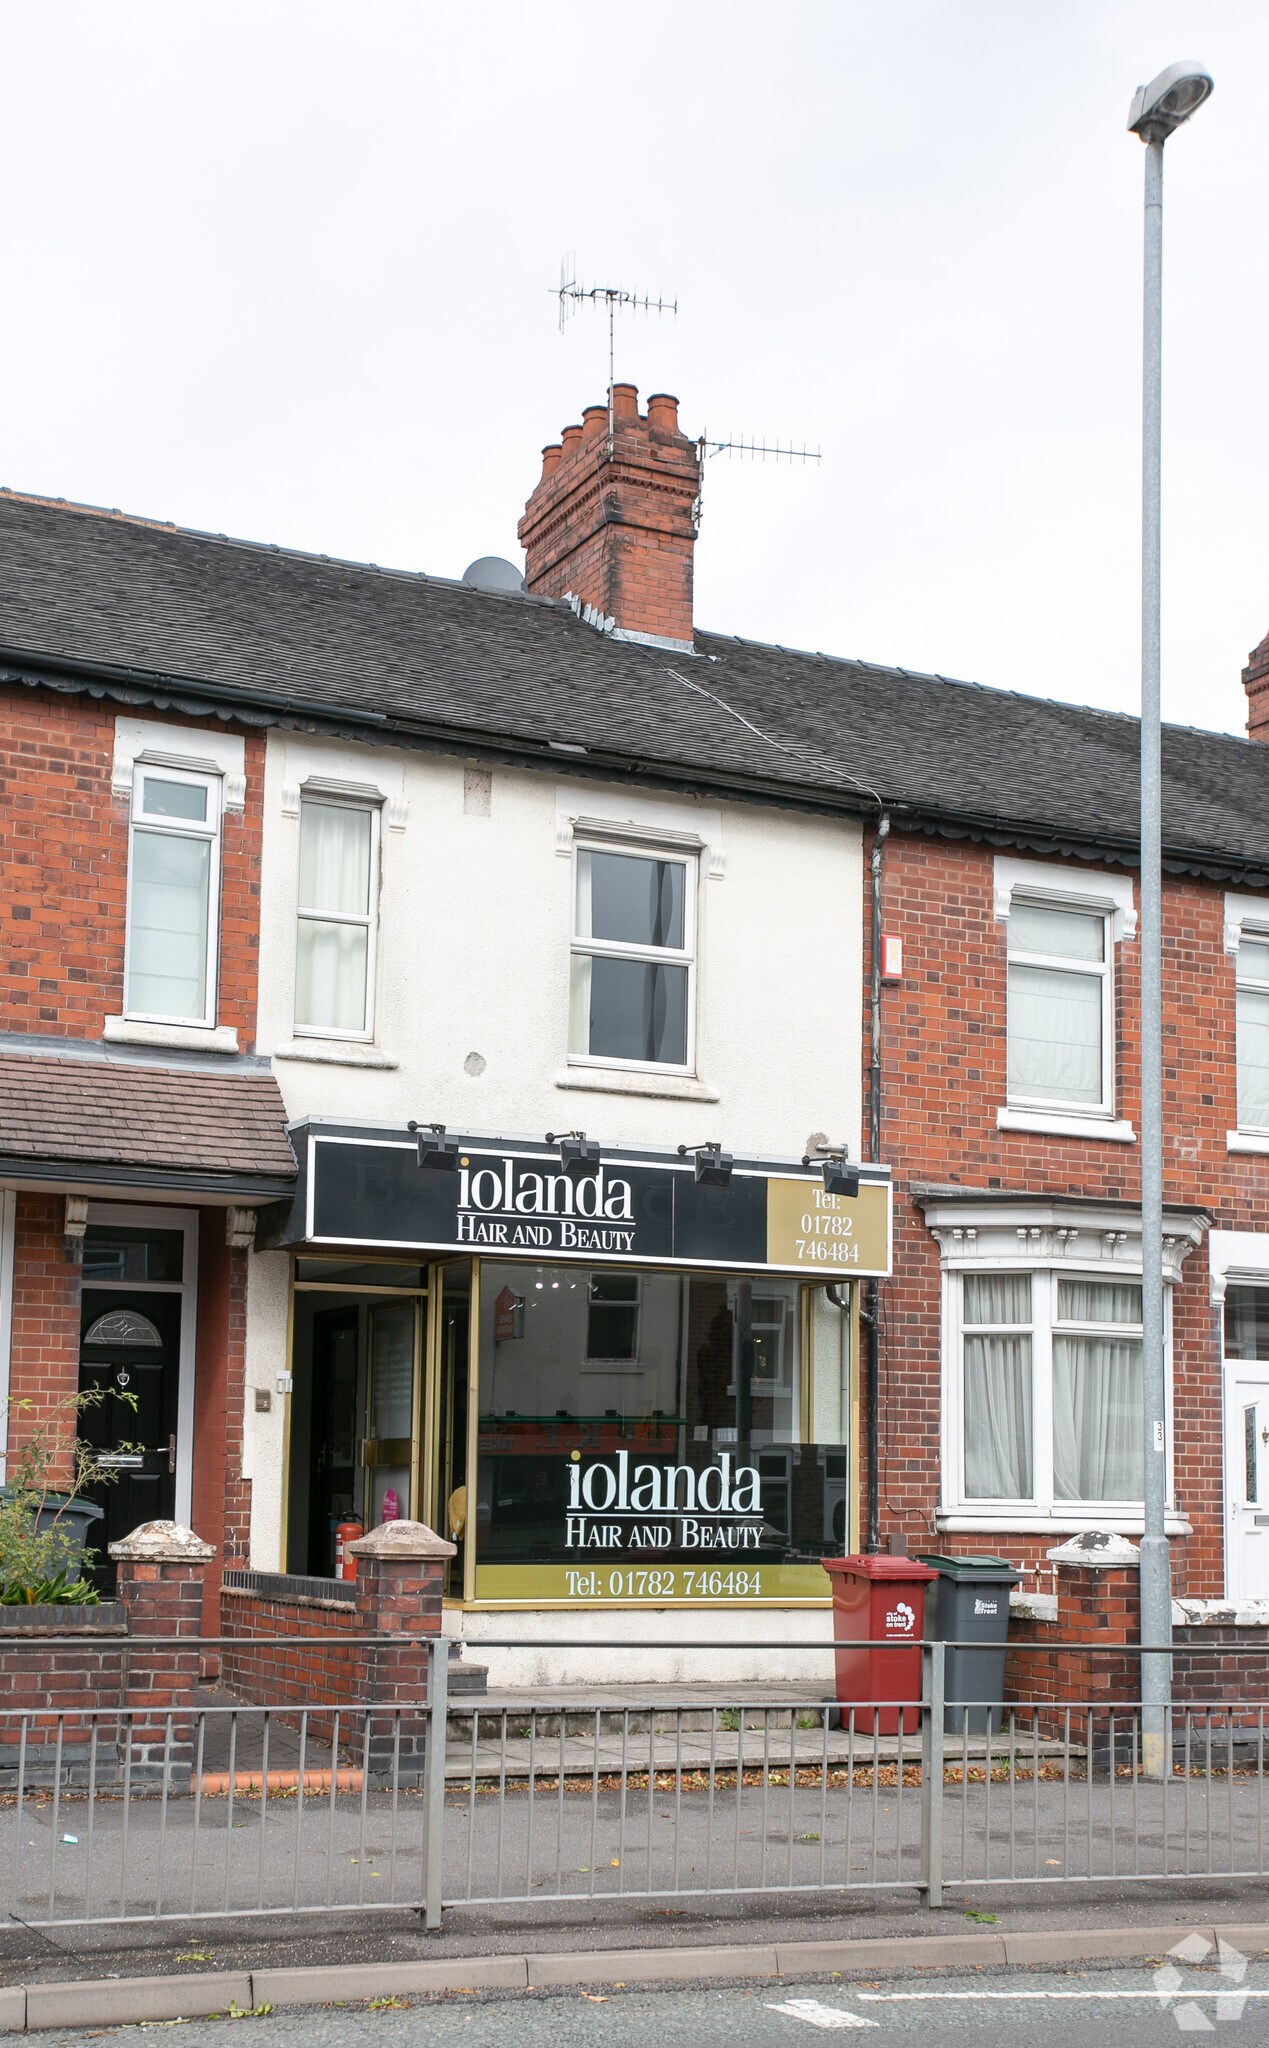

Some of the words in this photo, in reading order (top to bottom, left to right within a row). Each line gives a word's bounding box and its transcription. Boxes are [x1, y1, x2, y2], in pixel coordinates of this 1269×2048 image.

[457, 1157, 634, 1219] iolanda
[812, 1188, 841, 1210] Tel:
[456, 1215, 508, 1243] HAIR
[511, 1225, 552, 1246] AND
[560, 1221, 636, 1250] BEAUTY
[801, 1213, 853, 1236] 01782
[796, 1239, 859, 1263] 746484
[566, 1450, 764, 1512] iolanda
[565, 1517, 623, 1548] HAIR
[627, 1525, 672, 1548] AND
[680, 1518, 764, 1548] BEAUTY
[565, 1571, 602, 1596] Tel:
[609, 1571, 675, 1596] 01782
[683, 1571, 761, 1596] 746484
